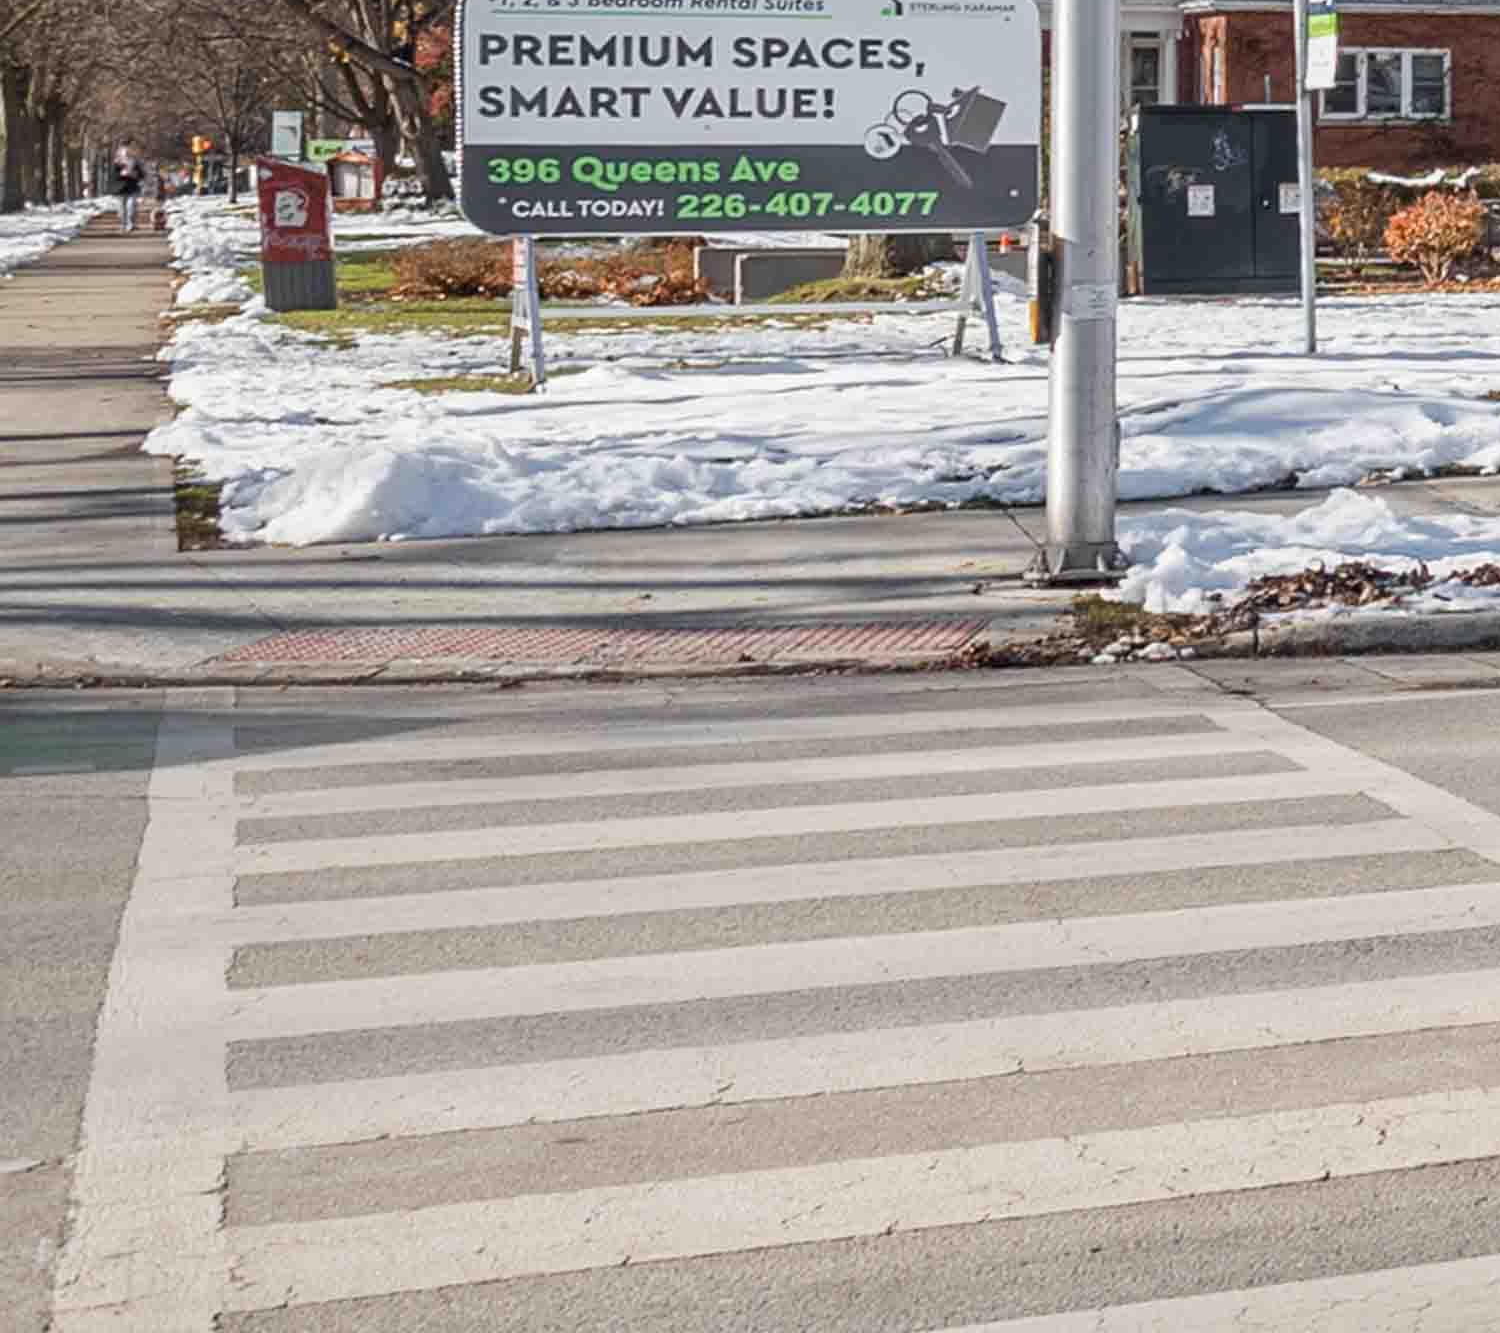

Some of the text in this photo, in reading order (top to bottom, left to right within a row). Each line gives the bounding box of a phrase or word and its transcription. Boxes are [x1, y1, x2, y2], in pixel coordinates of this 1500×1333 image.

[478, 33, 926, 78] PREMIUM SPACES,
[478, 85, 836, 120] SMART VALUE!
[487, 155, 800, 191] 396 Queens Ave
[511, 191, 940, 219] CALL TODAY! 226-407-4077
